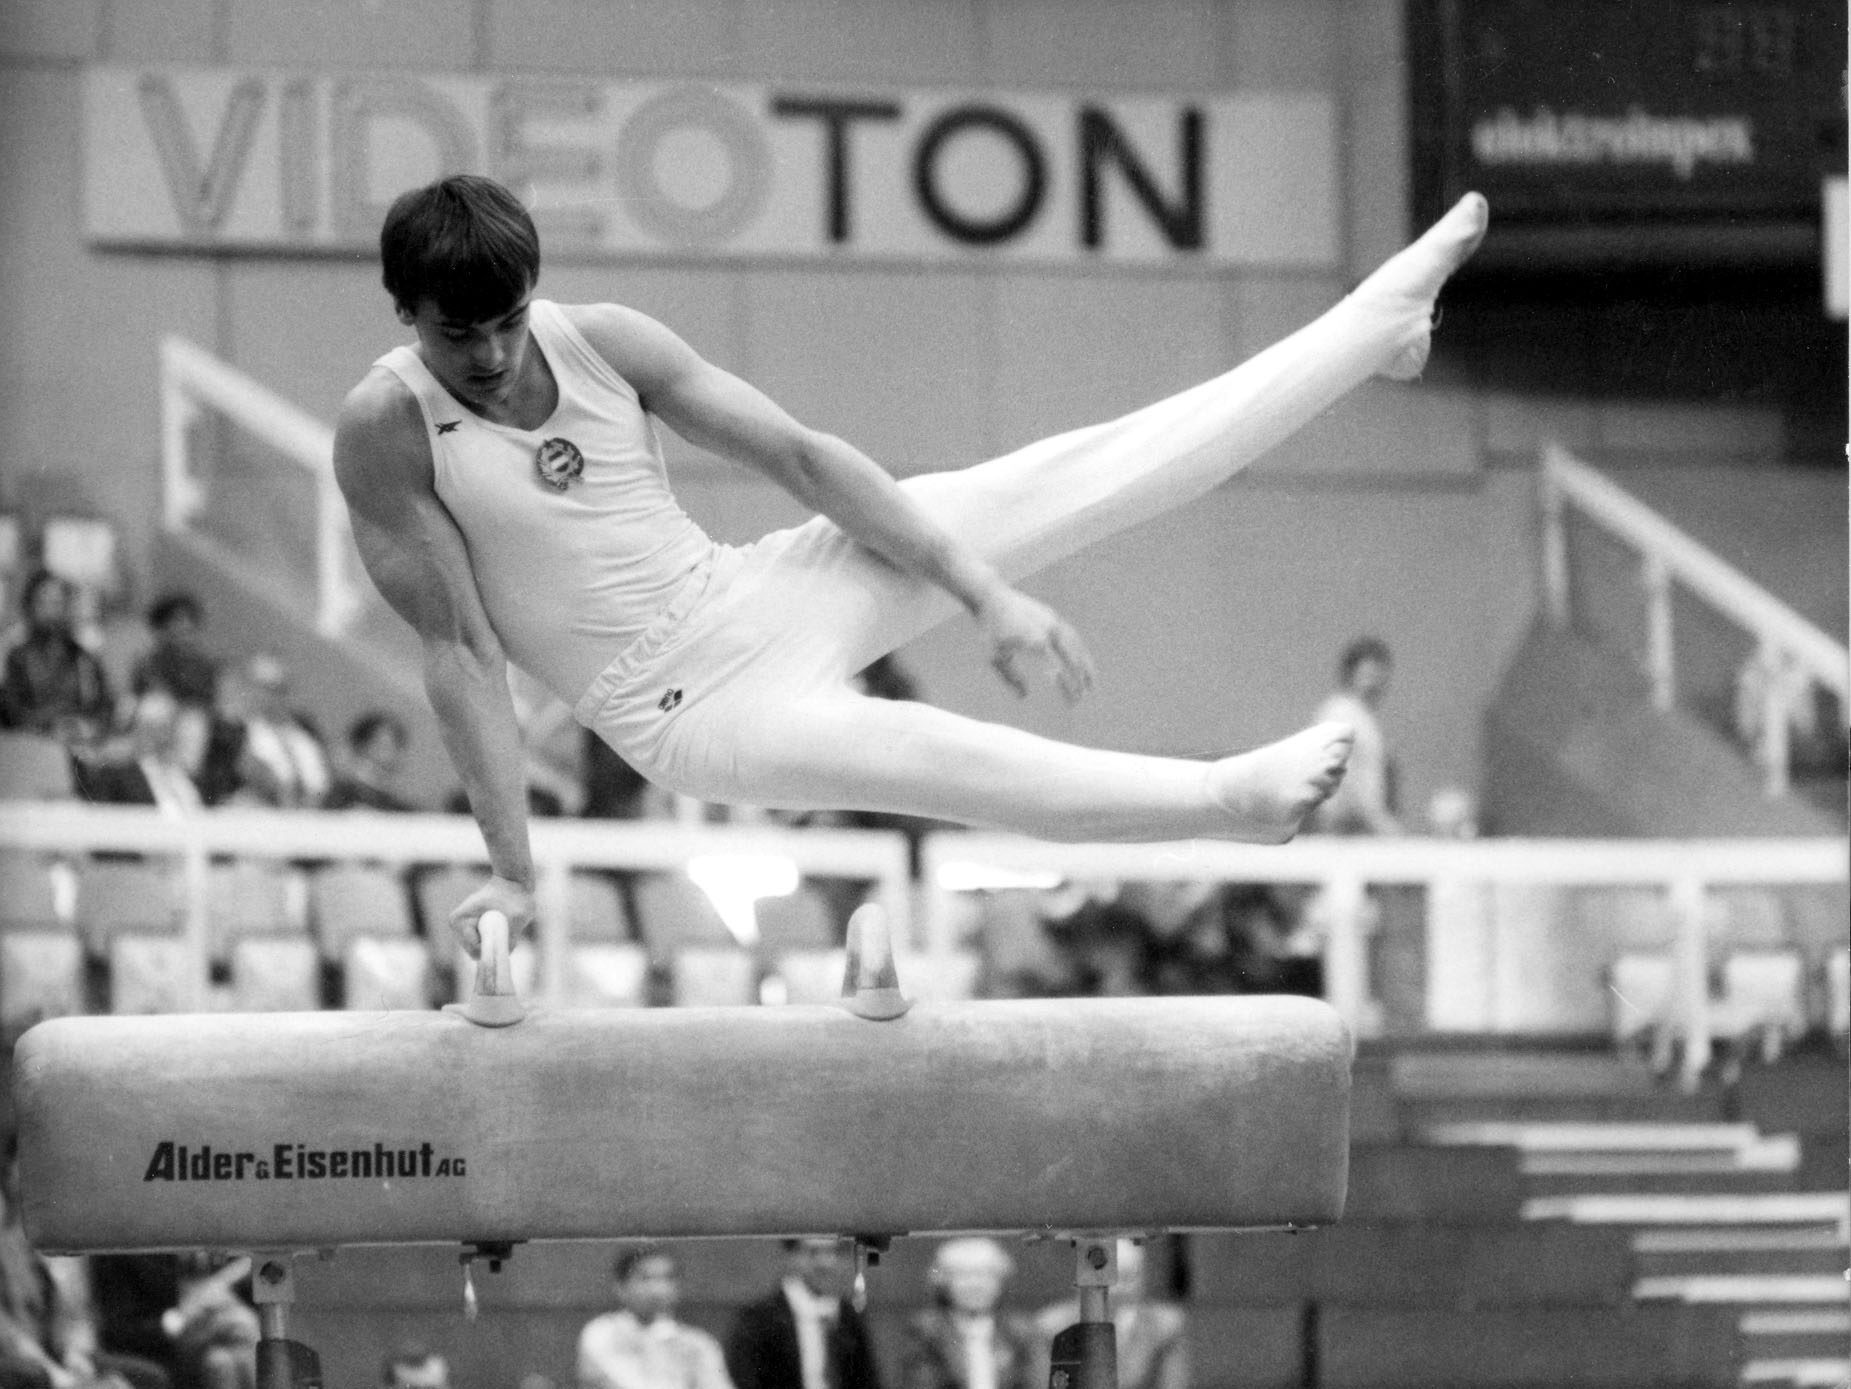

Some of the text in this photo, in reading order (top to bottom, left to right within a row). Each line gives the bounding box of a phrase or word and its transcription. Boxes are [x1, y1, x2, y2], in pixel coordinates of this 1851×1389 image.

[136, 74, 1206, 250] VIDEOTON
[143, 1141, 254, 1182] Alder
[273, 1142, 434, 1180] Eisenhut
[436, 1157, 466, 1178] AG
